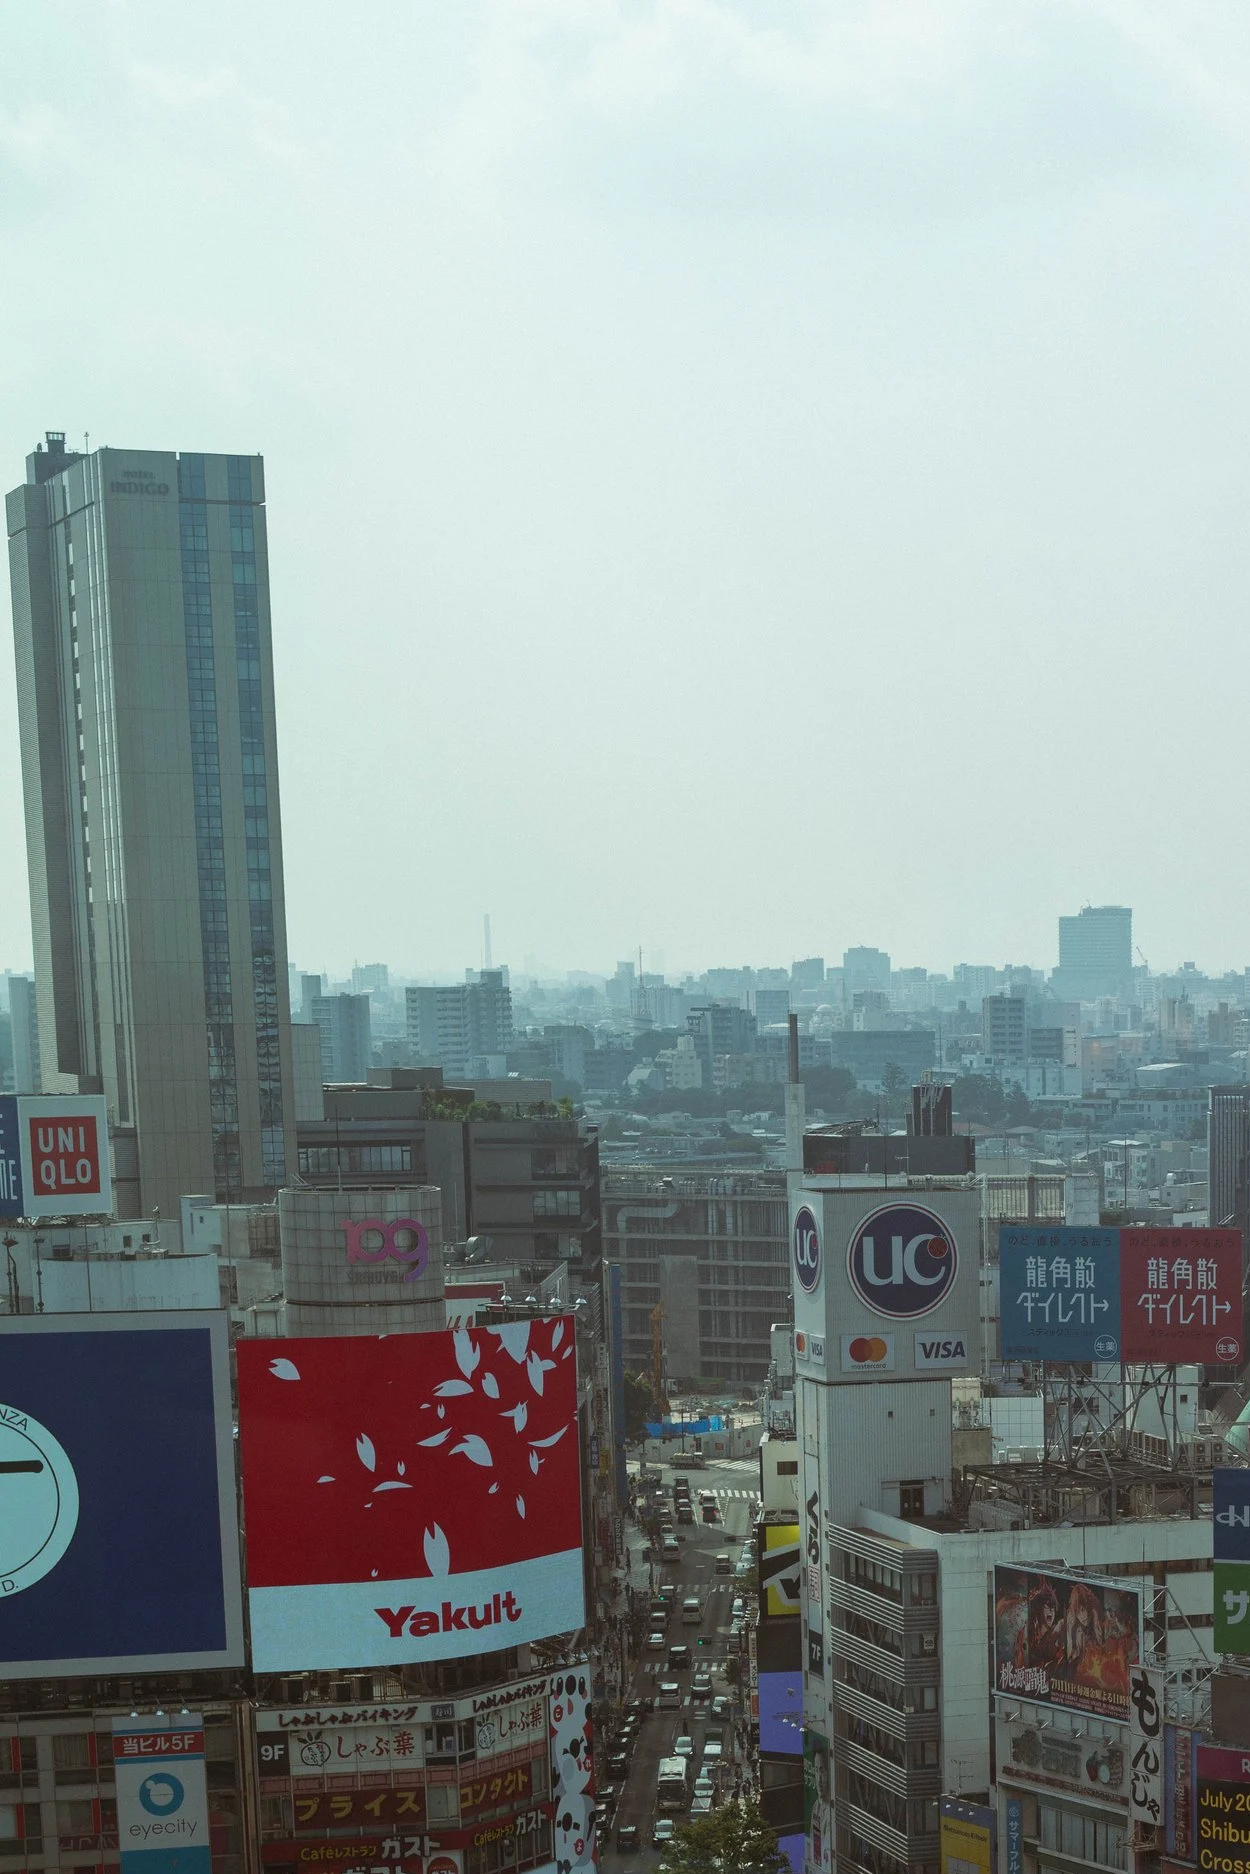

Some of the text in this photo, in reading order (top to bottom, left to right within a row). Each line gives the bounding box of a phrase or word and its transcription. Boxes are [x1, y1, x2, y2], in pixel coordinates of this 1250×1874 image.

[38, 1127, 86, 1152] UNI
[40, 1159, 92, 1190] QLO
[340, 1218, 429, 1283] 109
[1026, 1256, 1096, 1288] 龍角散
[1147, 1257, 1218, 1290] 龍角散
[1016, 1292, 1110, 1323] ダイレクト
[1137, 1294, 1232, 1326] ダイレクト
[918, 1341, 966, 1358] VISA
[374, 1591, 522, 1637] Yakult
[499, 1703, 542, 1738] しゃぶ葉
[123, 1735, 195, 1754] 当ビル5F
[261, 1745, 285, 1761] 9F
[337, 1731, 414, 1759] しゃぶ葉
[1131, 1671, 1160, 1822] もんじゃ
[296, 1768, 528, 1822] プライス コンタクト
[1200, 1789, 1233, 1813] July
[129, 1818, 197, 1840] eyecity
[516, 1809, 546, 1835] ガスト
[382, 1835, 441, 1860] ガスト
